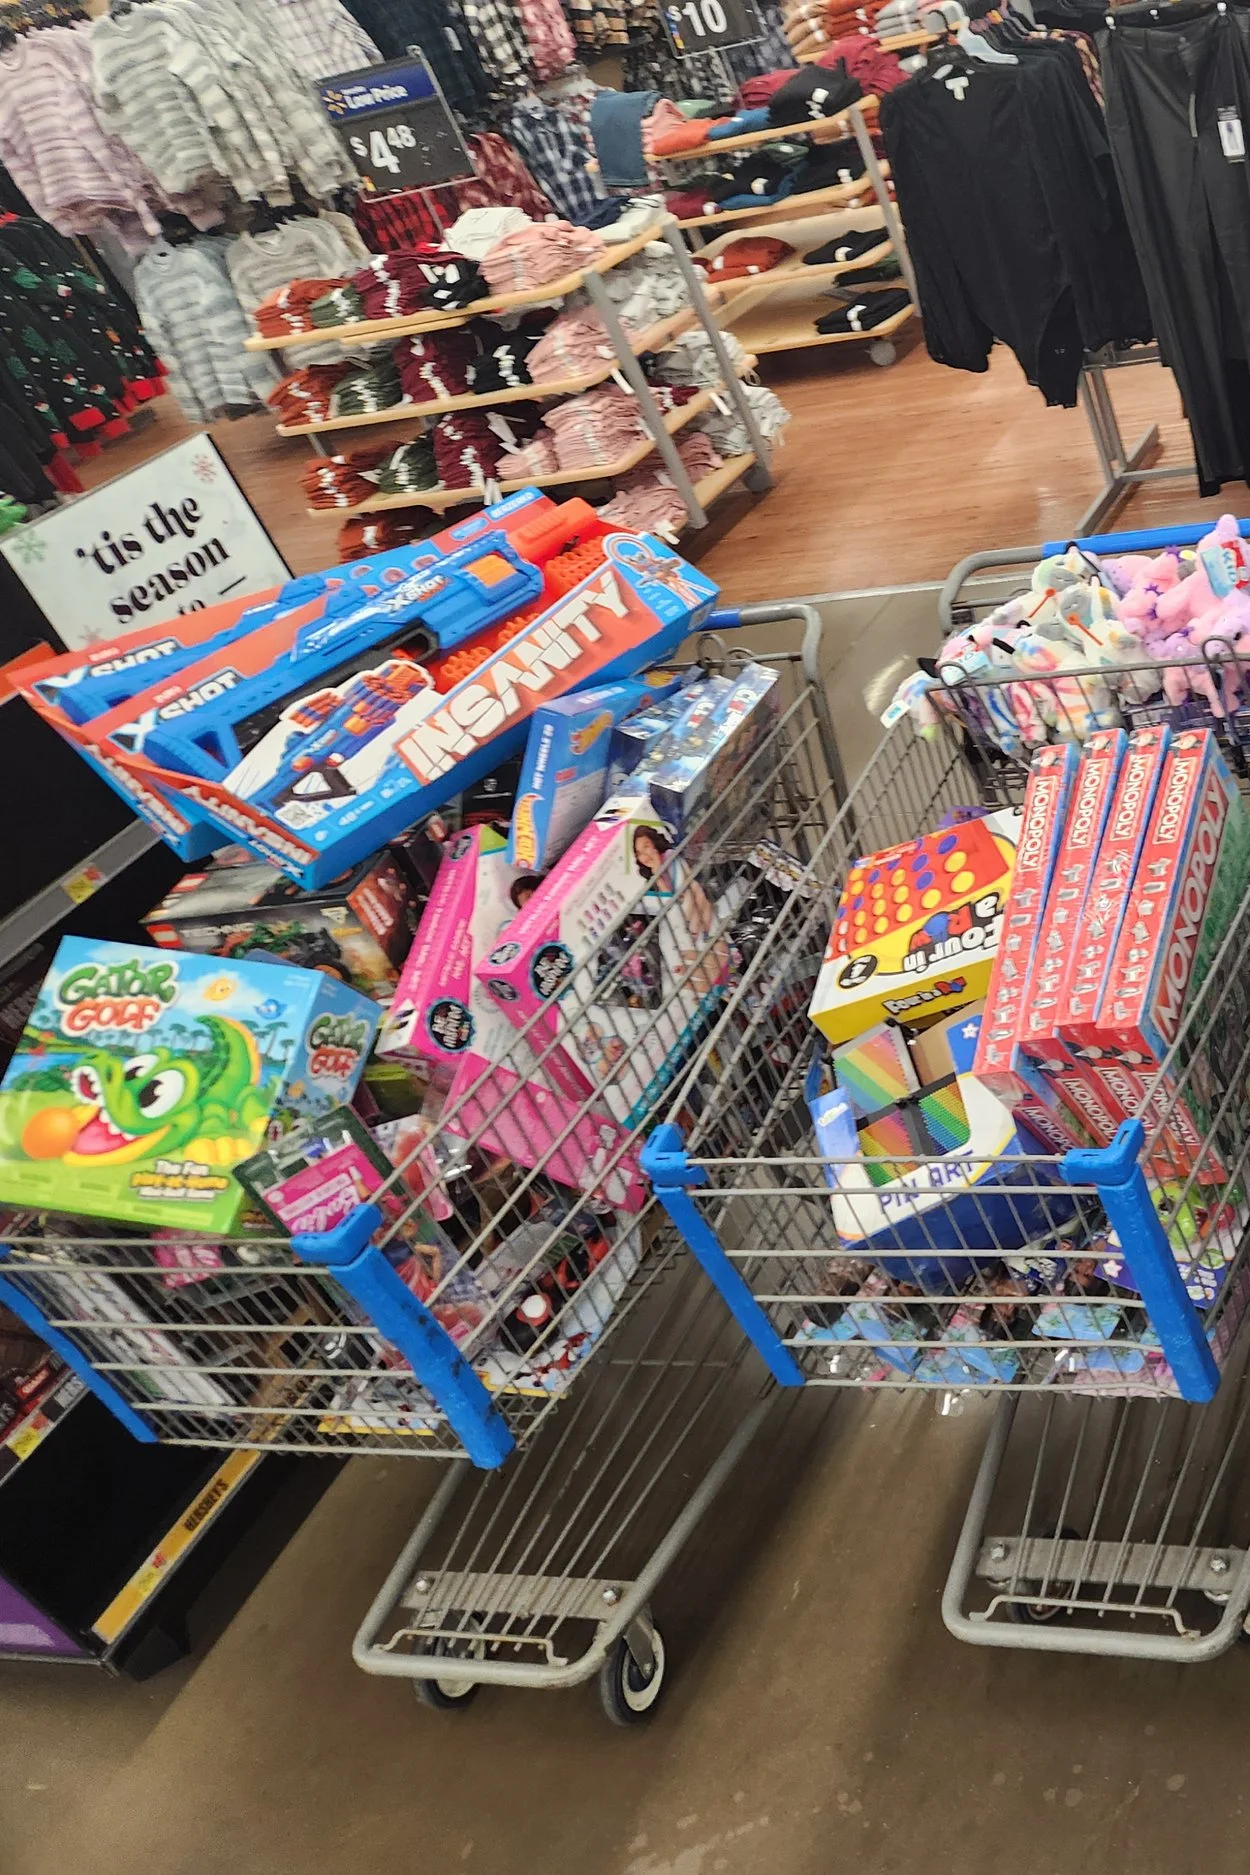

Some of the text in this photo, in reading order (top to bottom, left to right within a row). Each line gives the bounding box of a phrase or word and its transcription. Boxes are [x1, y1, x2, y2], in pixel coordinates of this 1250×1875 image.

[668, 0, 728, 36] $10
[74, 497, 205, 574] 'tis the
[110, 537, 230, 624] season
[397, 568, 631, 783] INSANITY
[1022, 779, 1055, 870] MONOPOLY
[1072, 760, 1103, 847] MONOPOLY
[1114, 755, 1147, 841] MONOPOLY
[1157, 758, 1191, 843] MONOPOLY
[929, 917, 1004, 963] Four
[974, 892, 1001, 918] a
[1156, 772, 1228, 1045] MONOPOLY
[59, 958, 177, 1005] GATOR
[903, 951, 930, 974] in
[66, 1000, 160, 1031] GOLF
[879, 1150, 974, 1214] PIN ART
